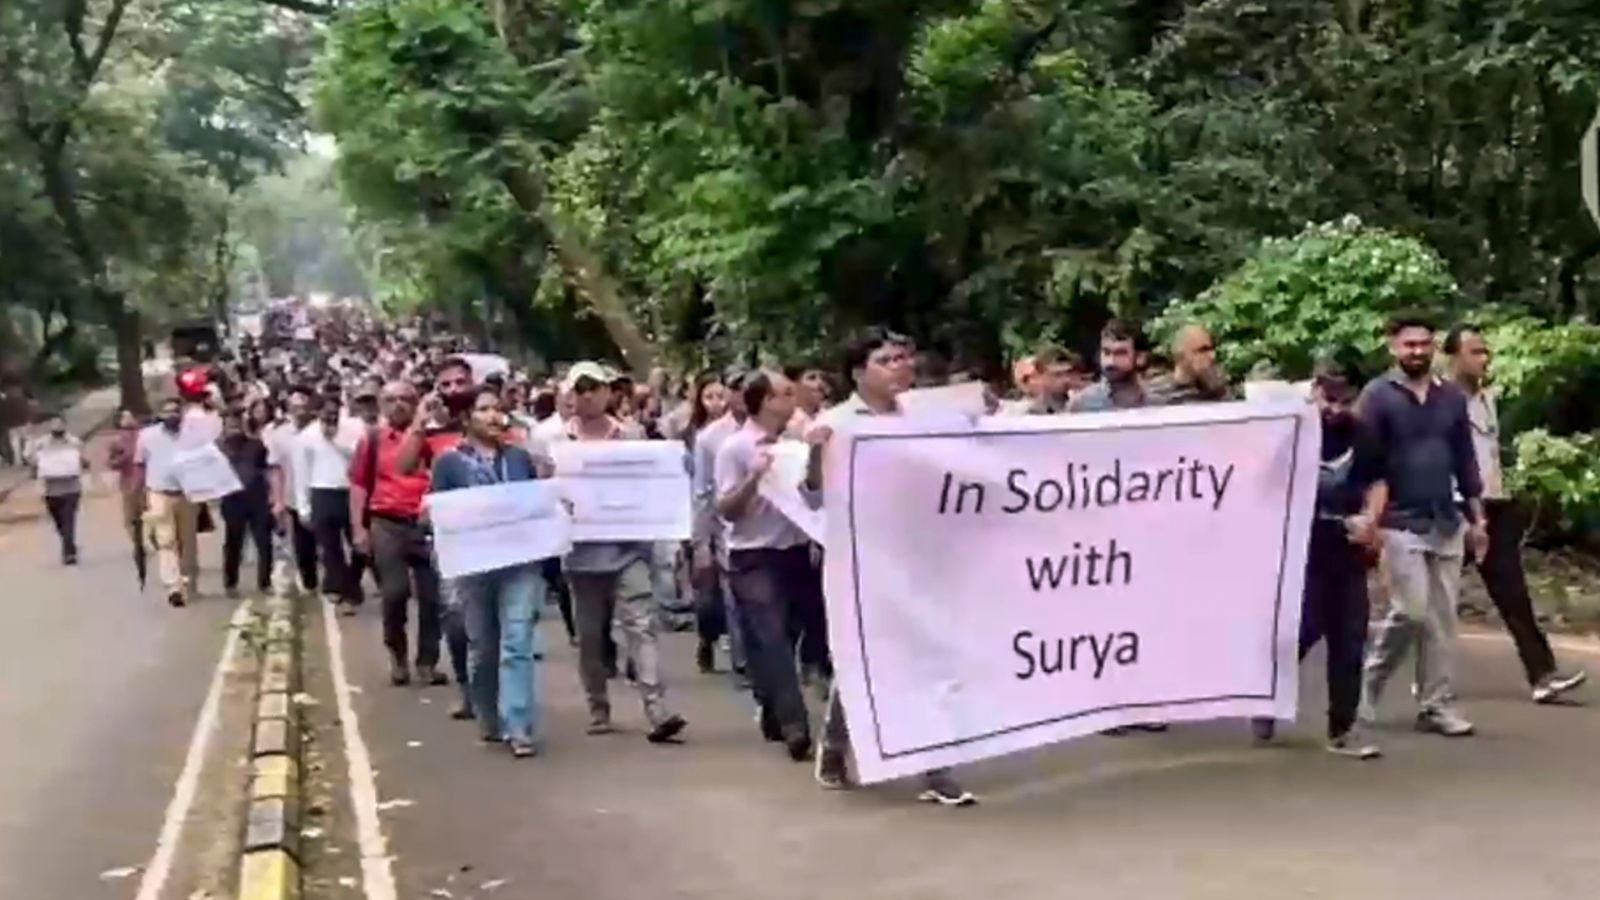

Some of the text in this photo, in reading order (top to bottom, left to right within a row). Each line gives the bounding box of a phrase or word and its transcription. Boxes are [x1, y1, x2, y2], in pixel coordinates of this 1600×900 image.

[938, 457, 1234, 514] In Solidarity
[1025, 539, 1132, 591] with
[1012, 630, 1140, 680] Surya
